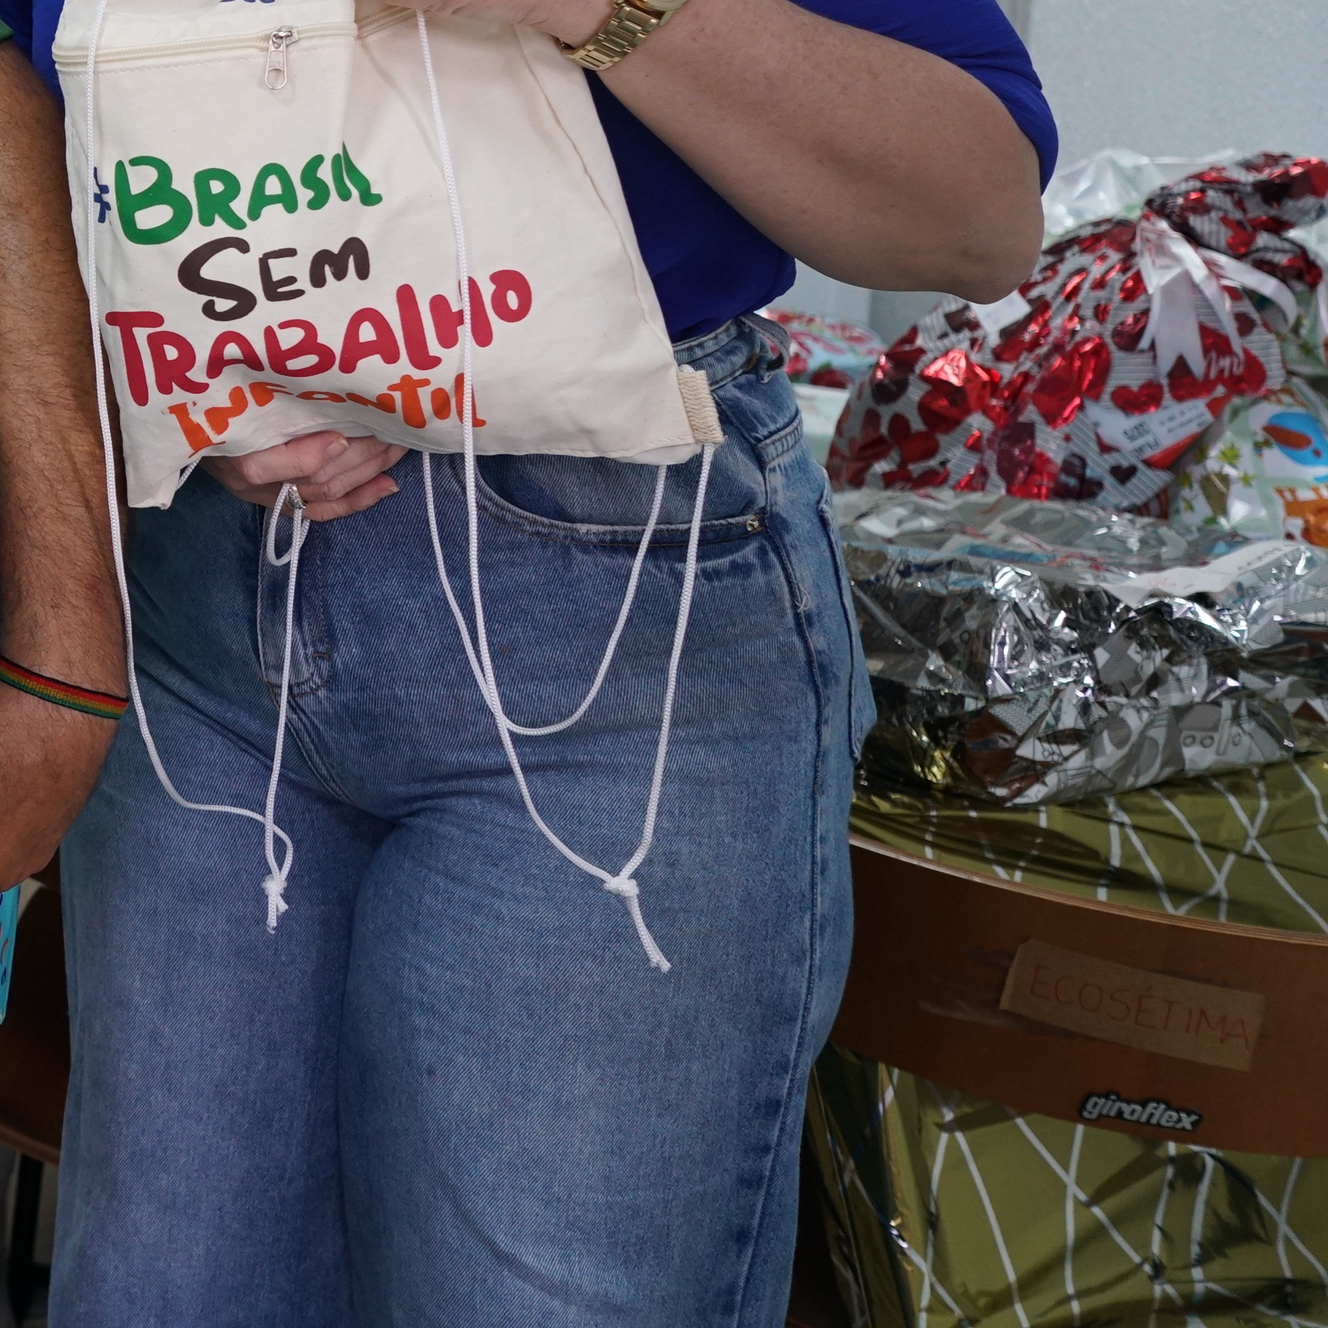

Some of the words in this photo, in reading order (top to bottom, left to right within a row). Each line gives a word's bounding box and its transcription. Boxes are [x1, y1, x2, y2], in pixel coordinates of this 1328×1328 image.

[177, 236, 371, 322] SEM
[1030, 964, 1251, 1050] ECOSÉTIMA
[1081, 1094, 1200, 1131] giroflex
